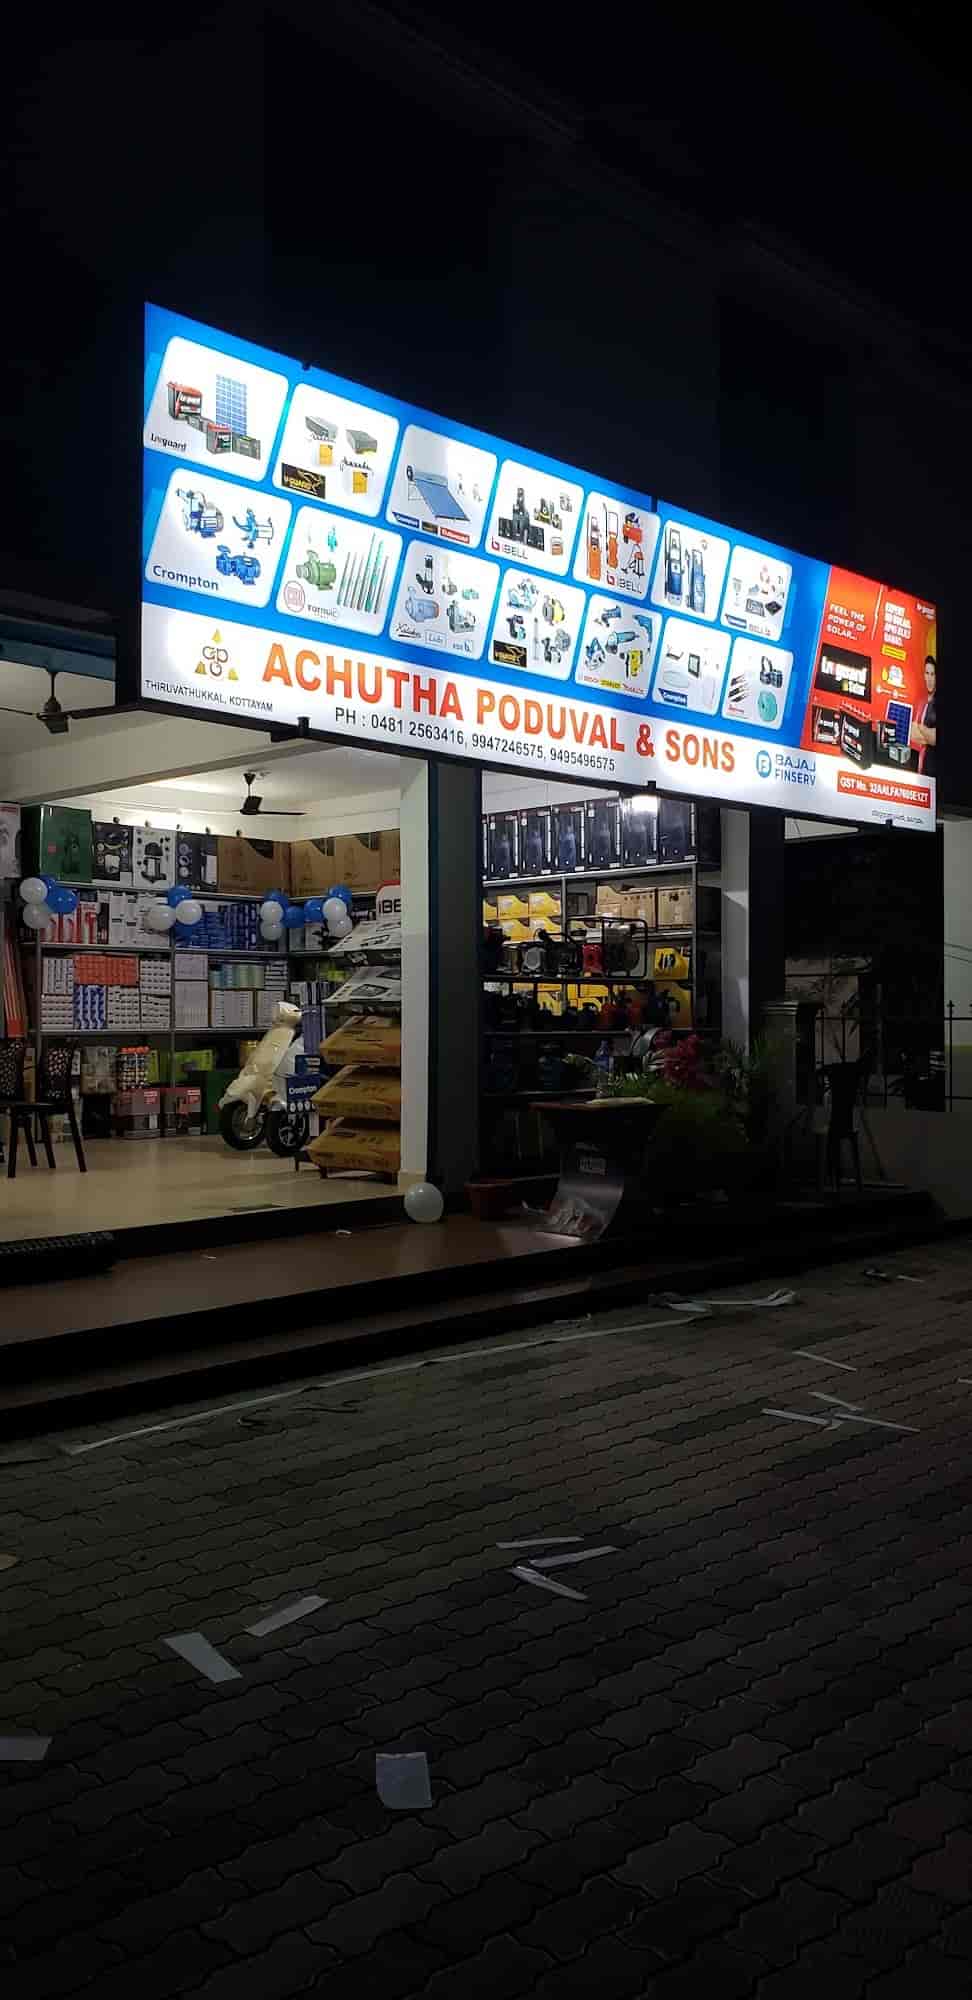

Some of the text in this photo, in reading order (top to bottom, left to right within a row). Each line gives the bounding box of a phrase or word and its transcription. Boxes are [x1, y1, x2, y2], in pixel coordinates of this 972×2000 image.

[153, 565, 219, 591] Crompton
[828, 614, 855, 630] POWER
[829, 604, 865, 622] FEEL THE
[145, 680, 274, 713] THIRUVATHUKKAL, KOTTAYAM
[262, 642, 736, 773] ACHUTHA PODUVAL & SONS
[335, 707, 356, 724] PH
[371, 711, 402, 734] 0481
[409, 720, 469, 750] 2563416,
[472, 733, 547, 761] 9947246575,
[549, 748, 616, 772] 9495496575
[775, 753, 816, 772] BAJAJ
[775, 769, 816, 787] FINSERV
